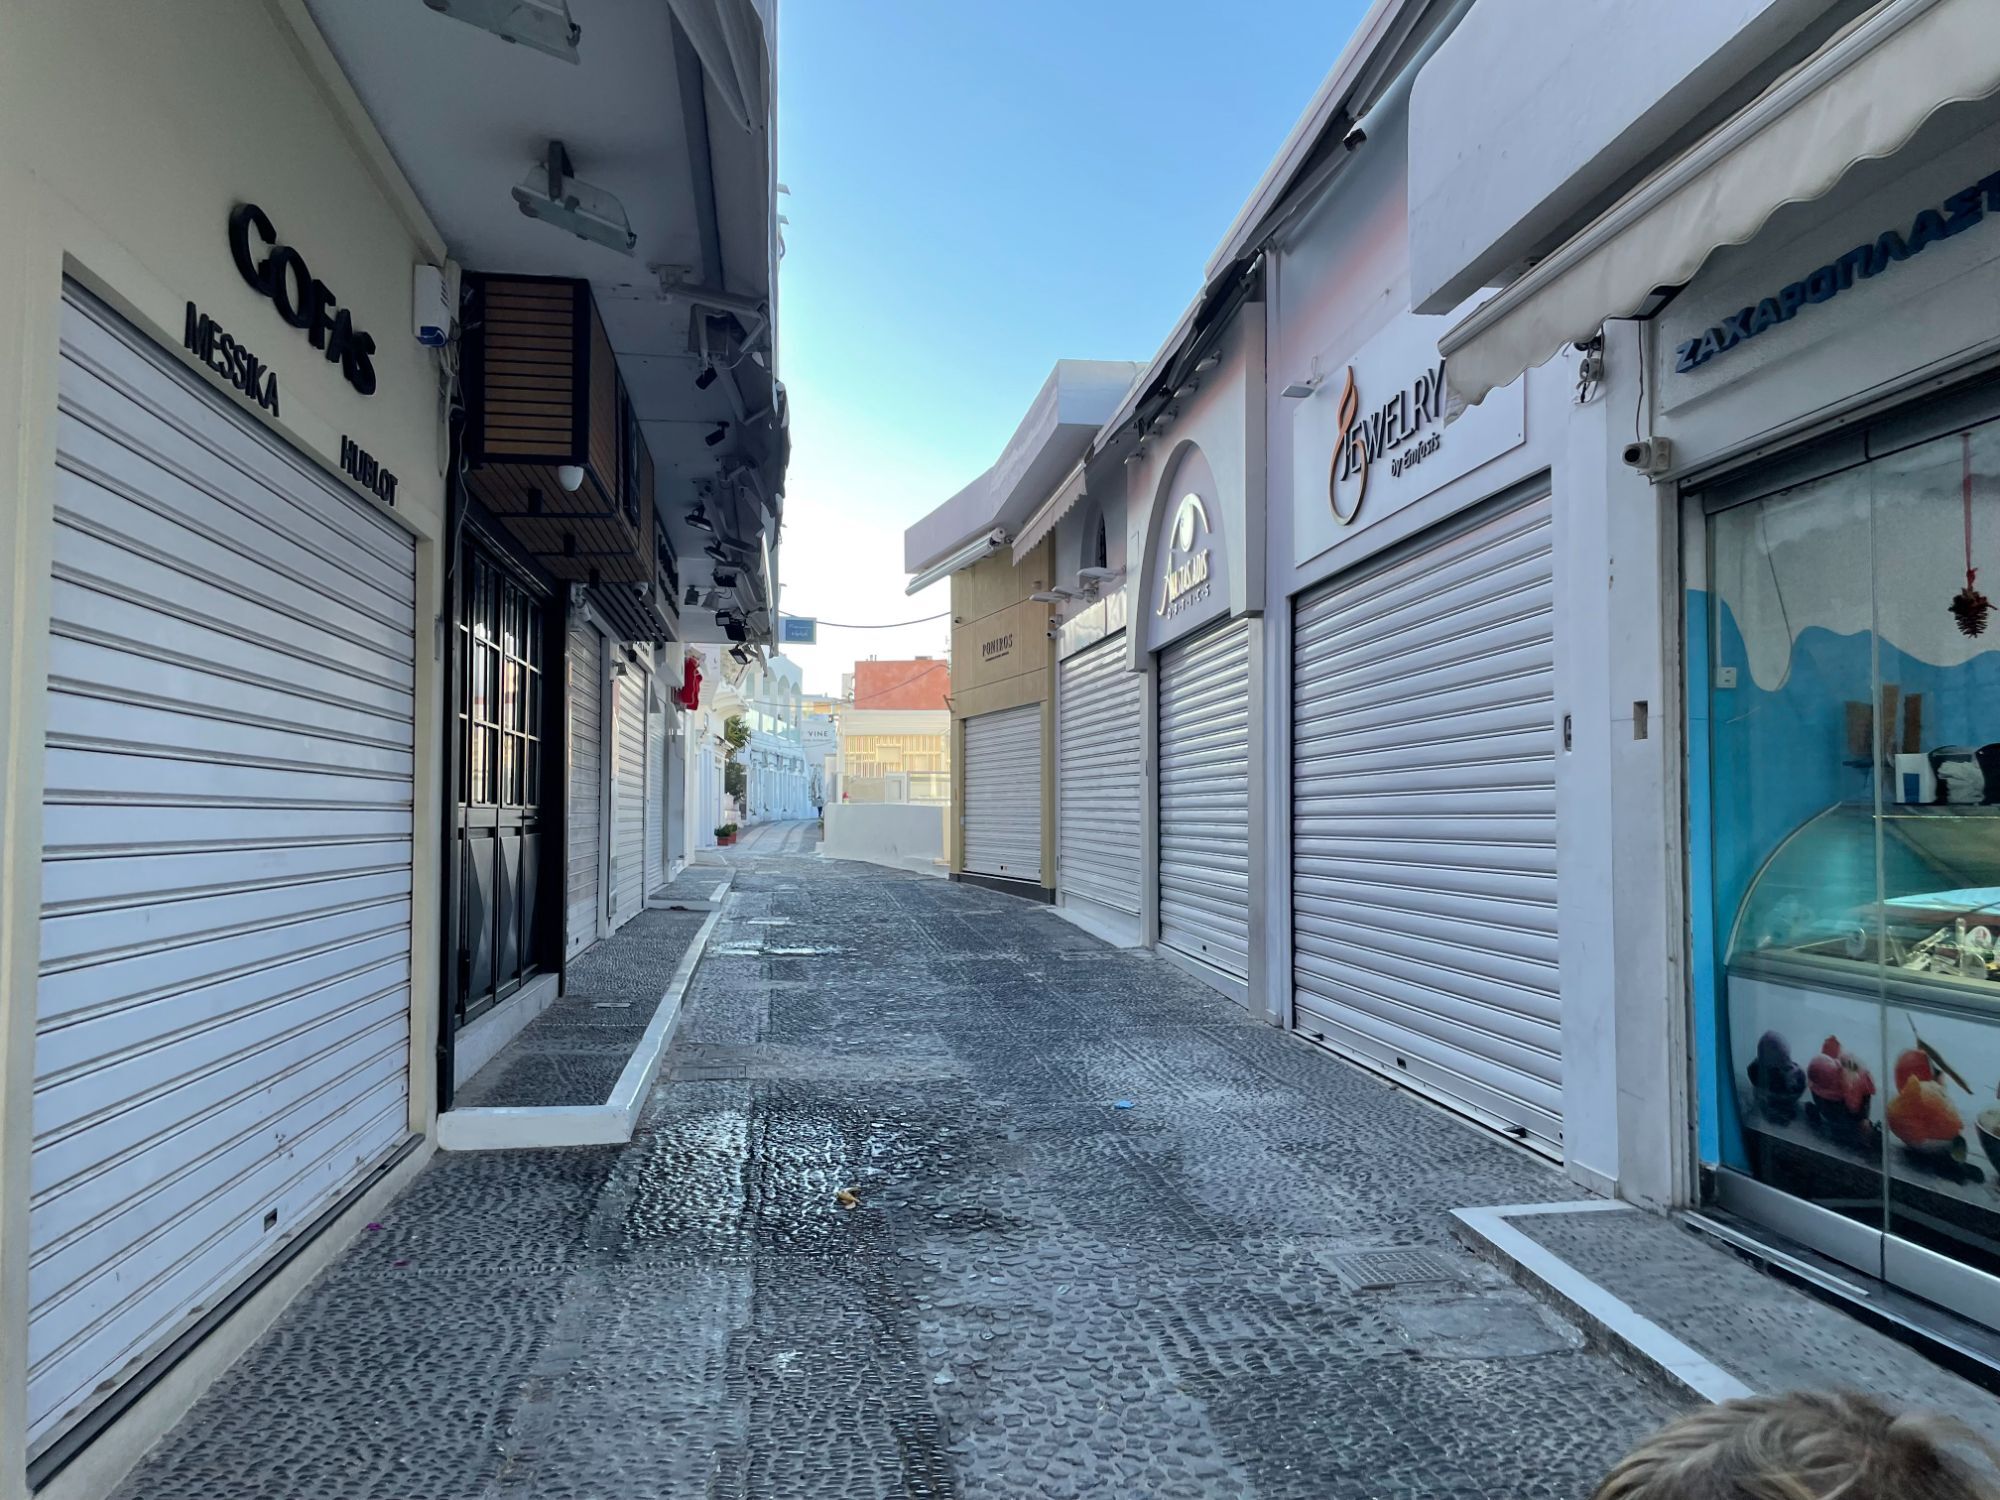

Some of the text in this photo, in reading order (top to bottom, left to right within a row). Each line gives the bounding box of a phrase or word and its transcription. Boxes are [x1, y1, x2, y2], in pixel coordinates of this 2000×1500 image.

[229, 203, 377, 396] GOFAS
[184, 301, 280, 418] MESSIKA
[340, 434, 399, 507] HUBLOT
[1340, 359, 1446, 482] JEWELRY
[1391, 457, 1403, 478] by
